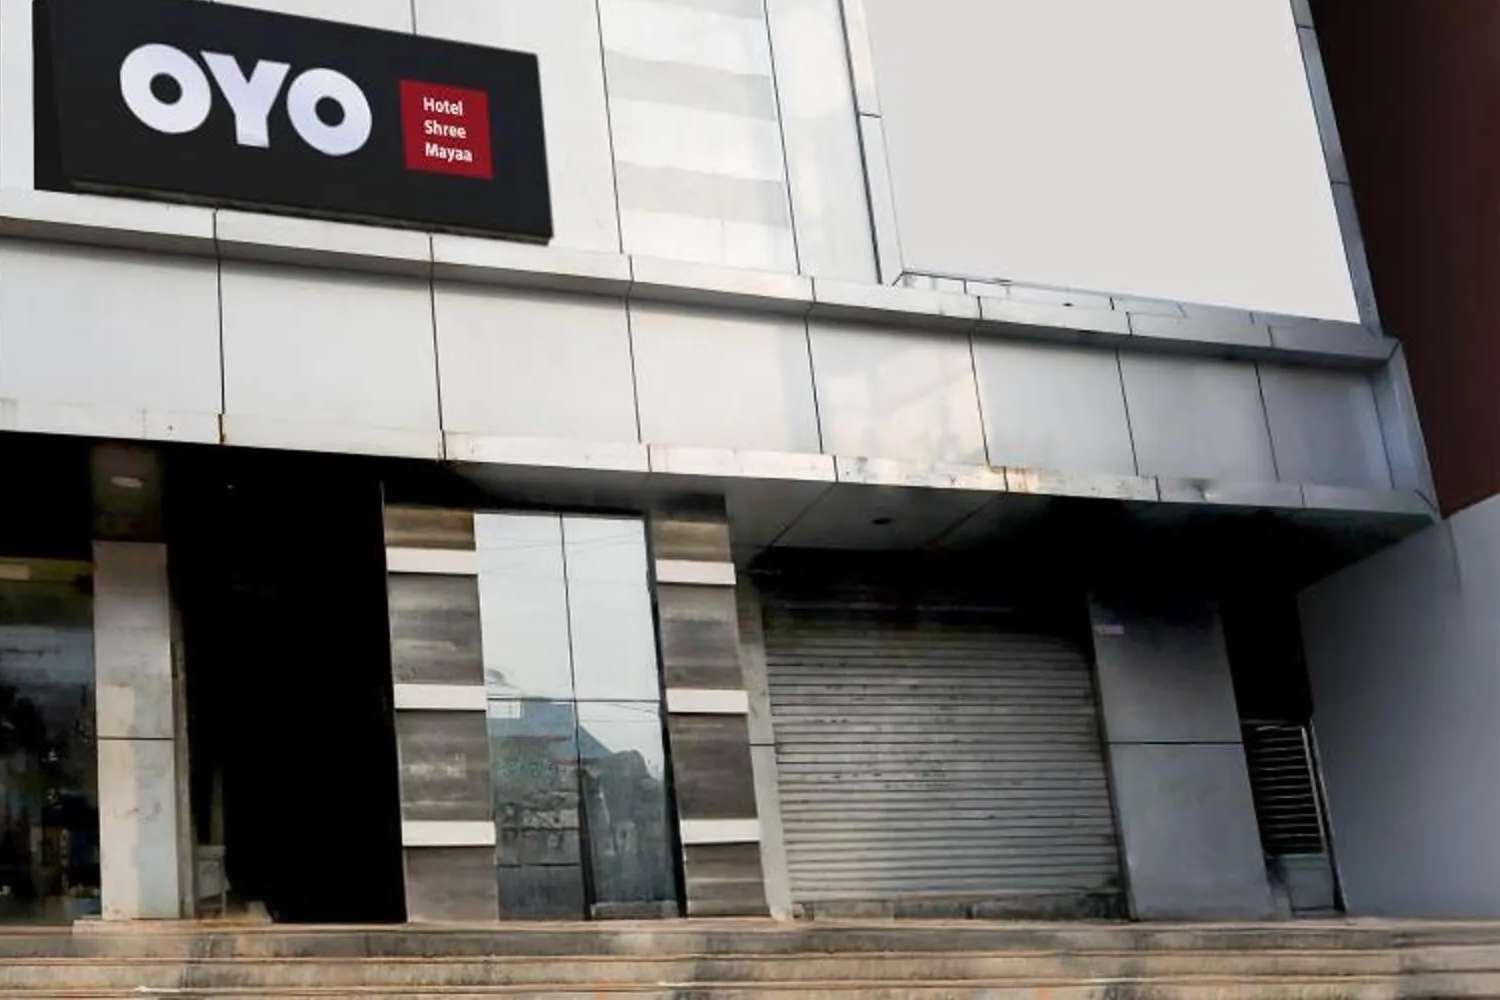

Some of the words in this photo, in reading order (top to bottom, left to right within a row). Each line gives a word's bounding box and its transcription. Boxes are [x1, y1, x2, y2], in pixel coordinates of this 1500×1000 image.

[119, 43, 373, 157] OYO
[423, 96, 464, 117] Hotel
[423, 119, 467, 139] Shree
[425, 141, 473, 163] Mayaa
